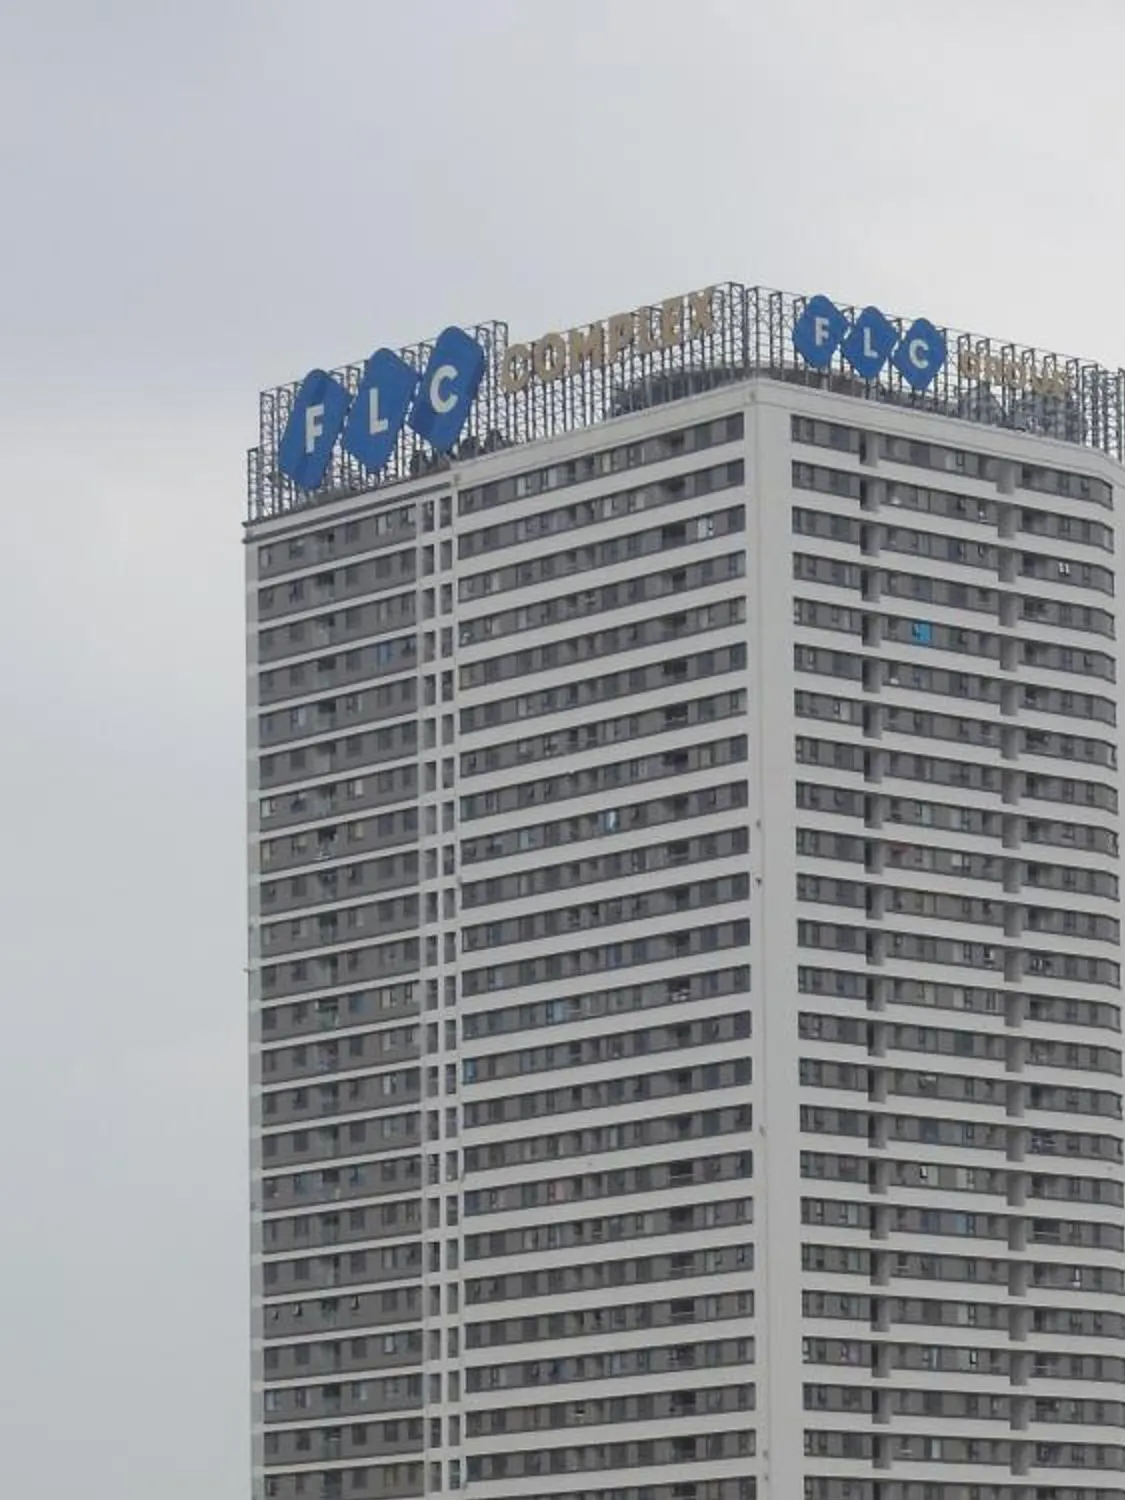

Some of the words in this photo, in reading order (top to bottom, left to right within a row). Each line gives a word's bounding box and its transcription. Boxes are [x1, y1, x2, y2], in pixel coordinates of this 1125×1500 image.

[305, 363, 459, 454] FLC
[500, 286, 714, 395] COMPLEX
[814, 318, 929, 370] FLC
